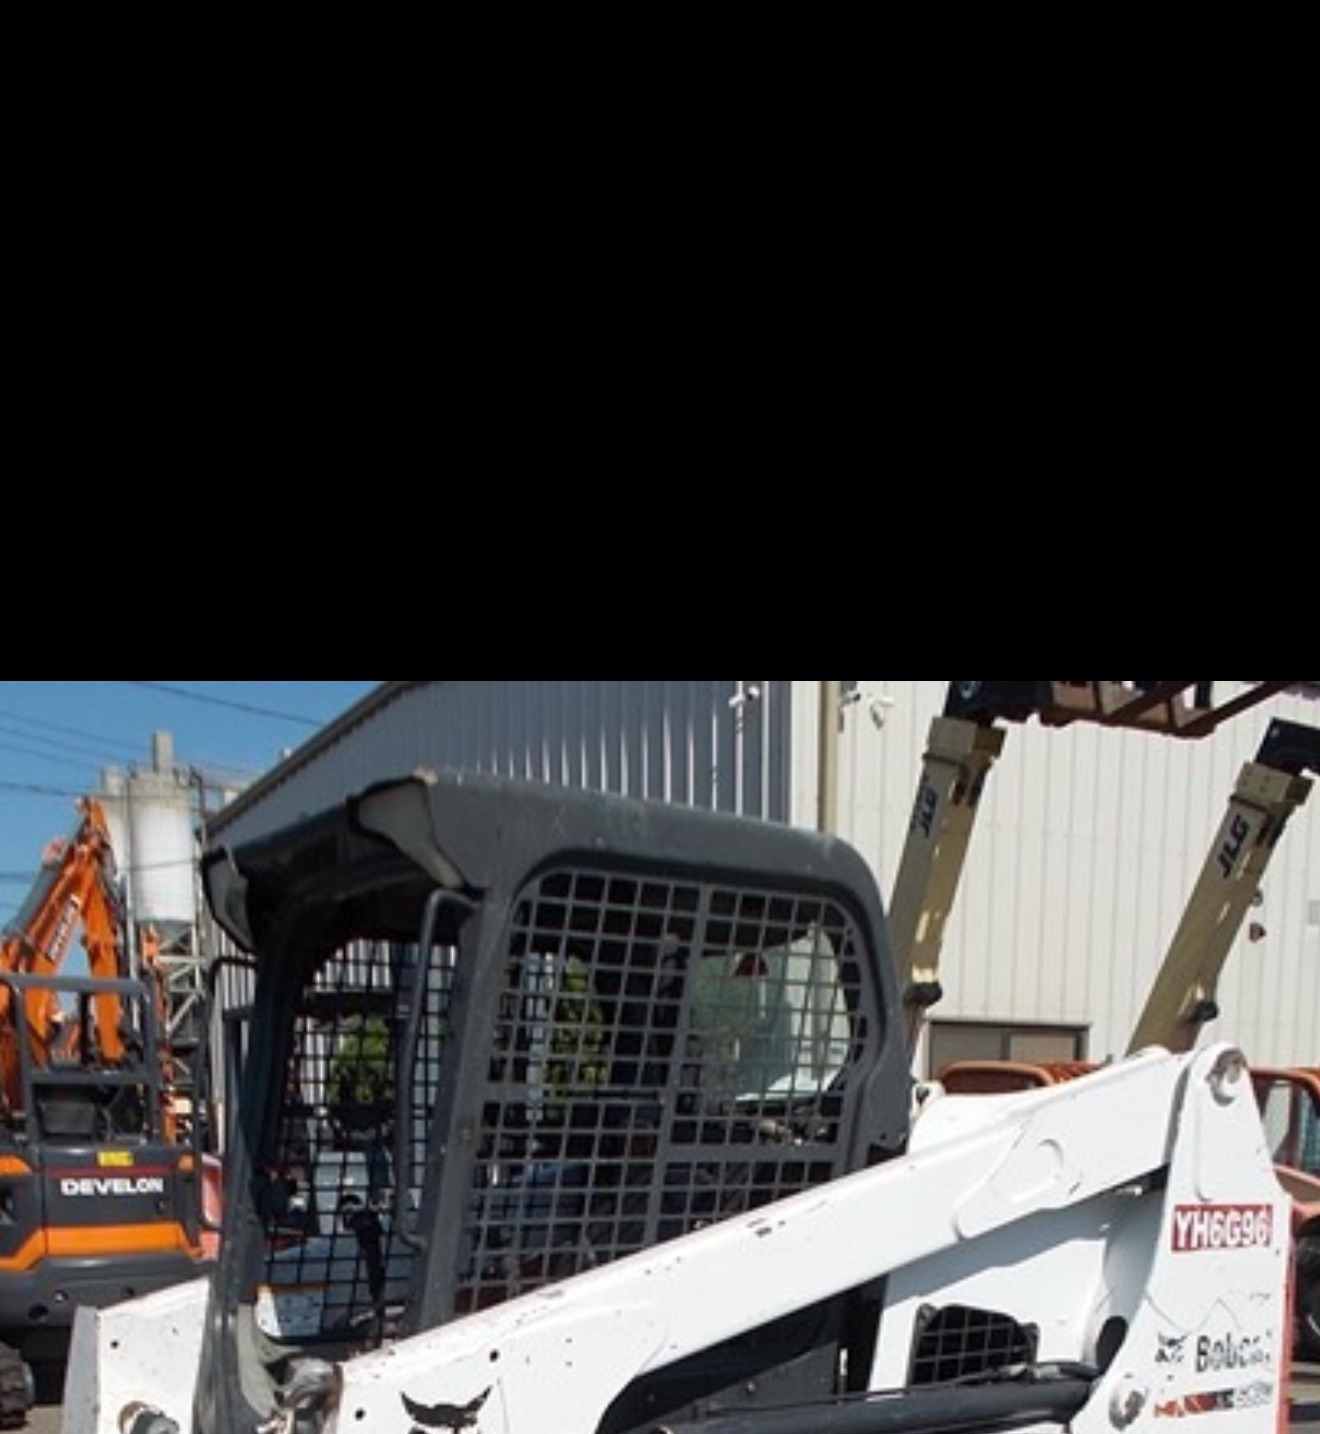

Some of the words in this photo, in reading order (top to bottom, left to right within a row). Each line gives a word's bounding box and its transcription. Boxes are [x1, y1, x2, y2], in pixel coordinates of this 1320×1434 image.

[1219, 814, 1249, 879] JLG
[61, 1177, 164, 1196] DEVELON
[1175, 1209, 1268, 1249] YH6G96
